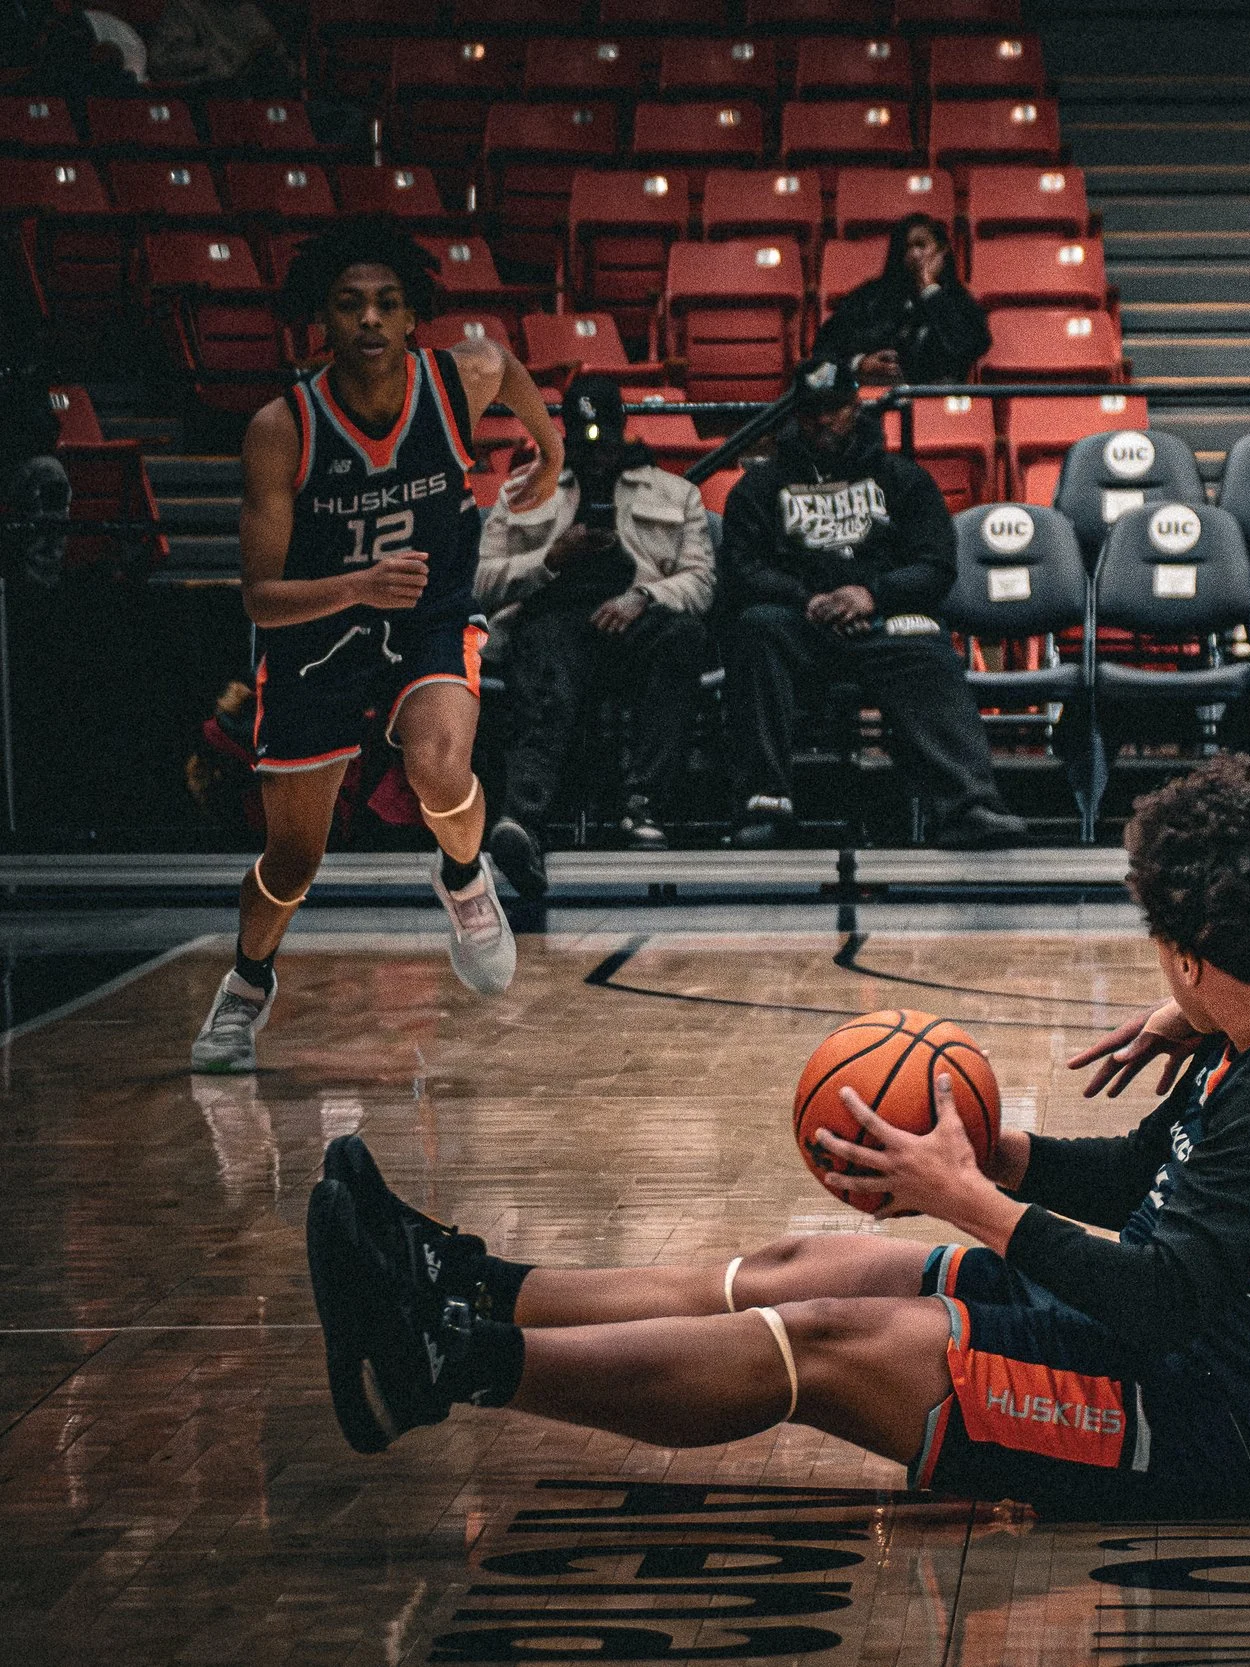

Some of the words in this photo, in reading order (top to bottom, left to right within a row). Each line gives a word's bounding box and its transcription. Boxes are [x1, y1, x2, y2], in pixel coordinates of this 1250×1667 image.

[1112, 447, 1148, 462] UIC
[313, 472, 447, 514] HUSKIES
[343, 510, 414, 563] 12
[990, 521, 1027, 537] UIC
[1157, 521, 1193, 536] UIC
[986, 1387, 1121, 1434] HUSKIES
[427, 1479, 938, 1661] Arena
